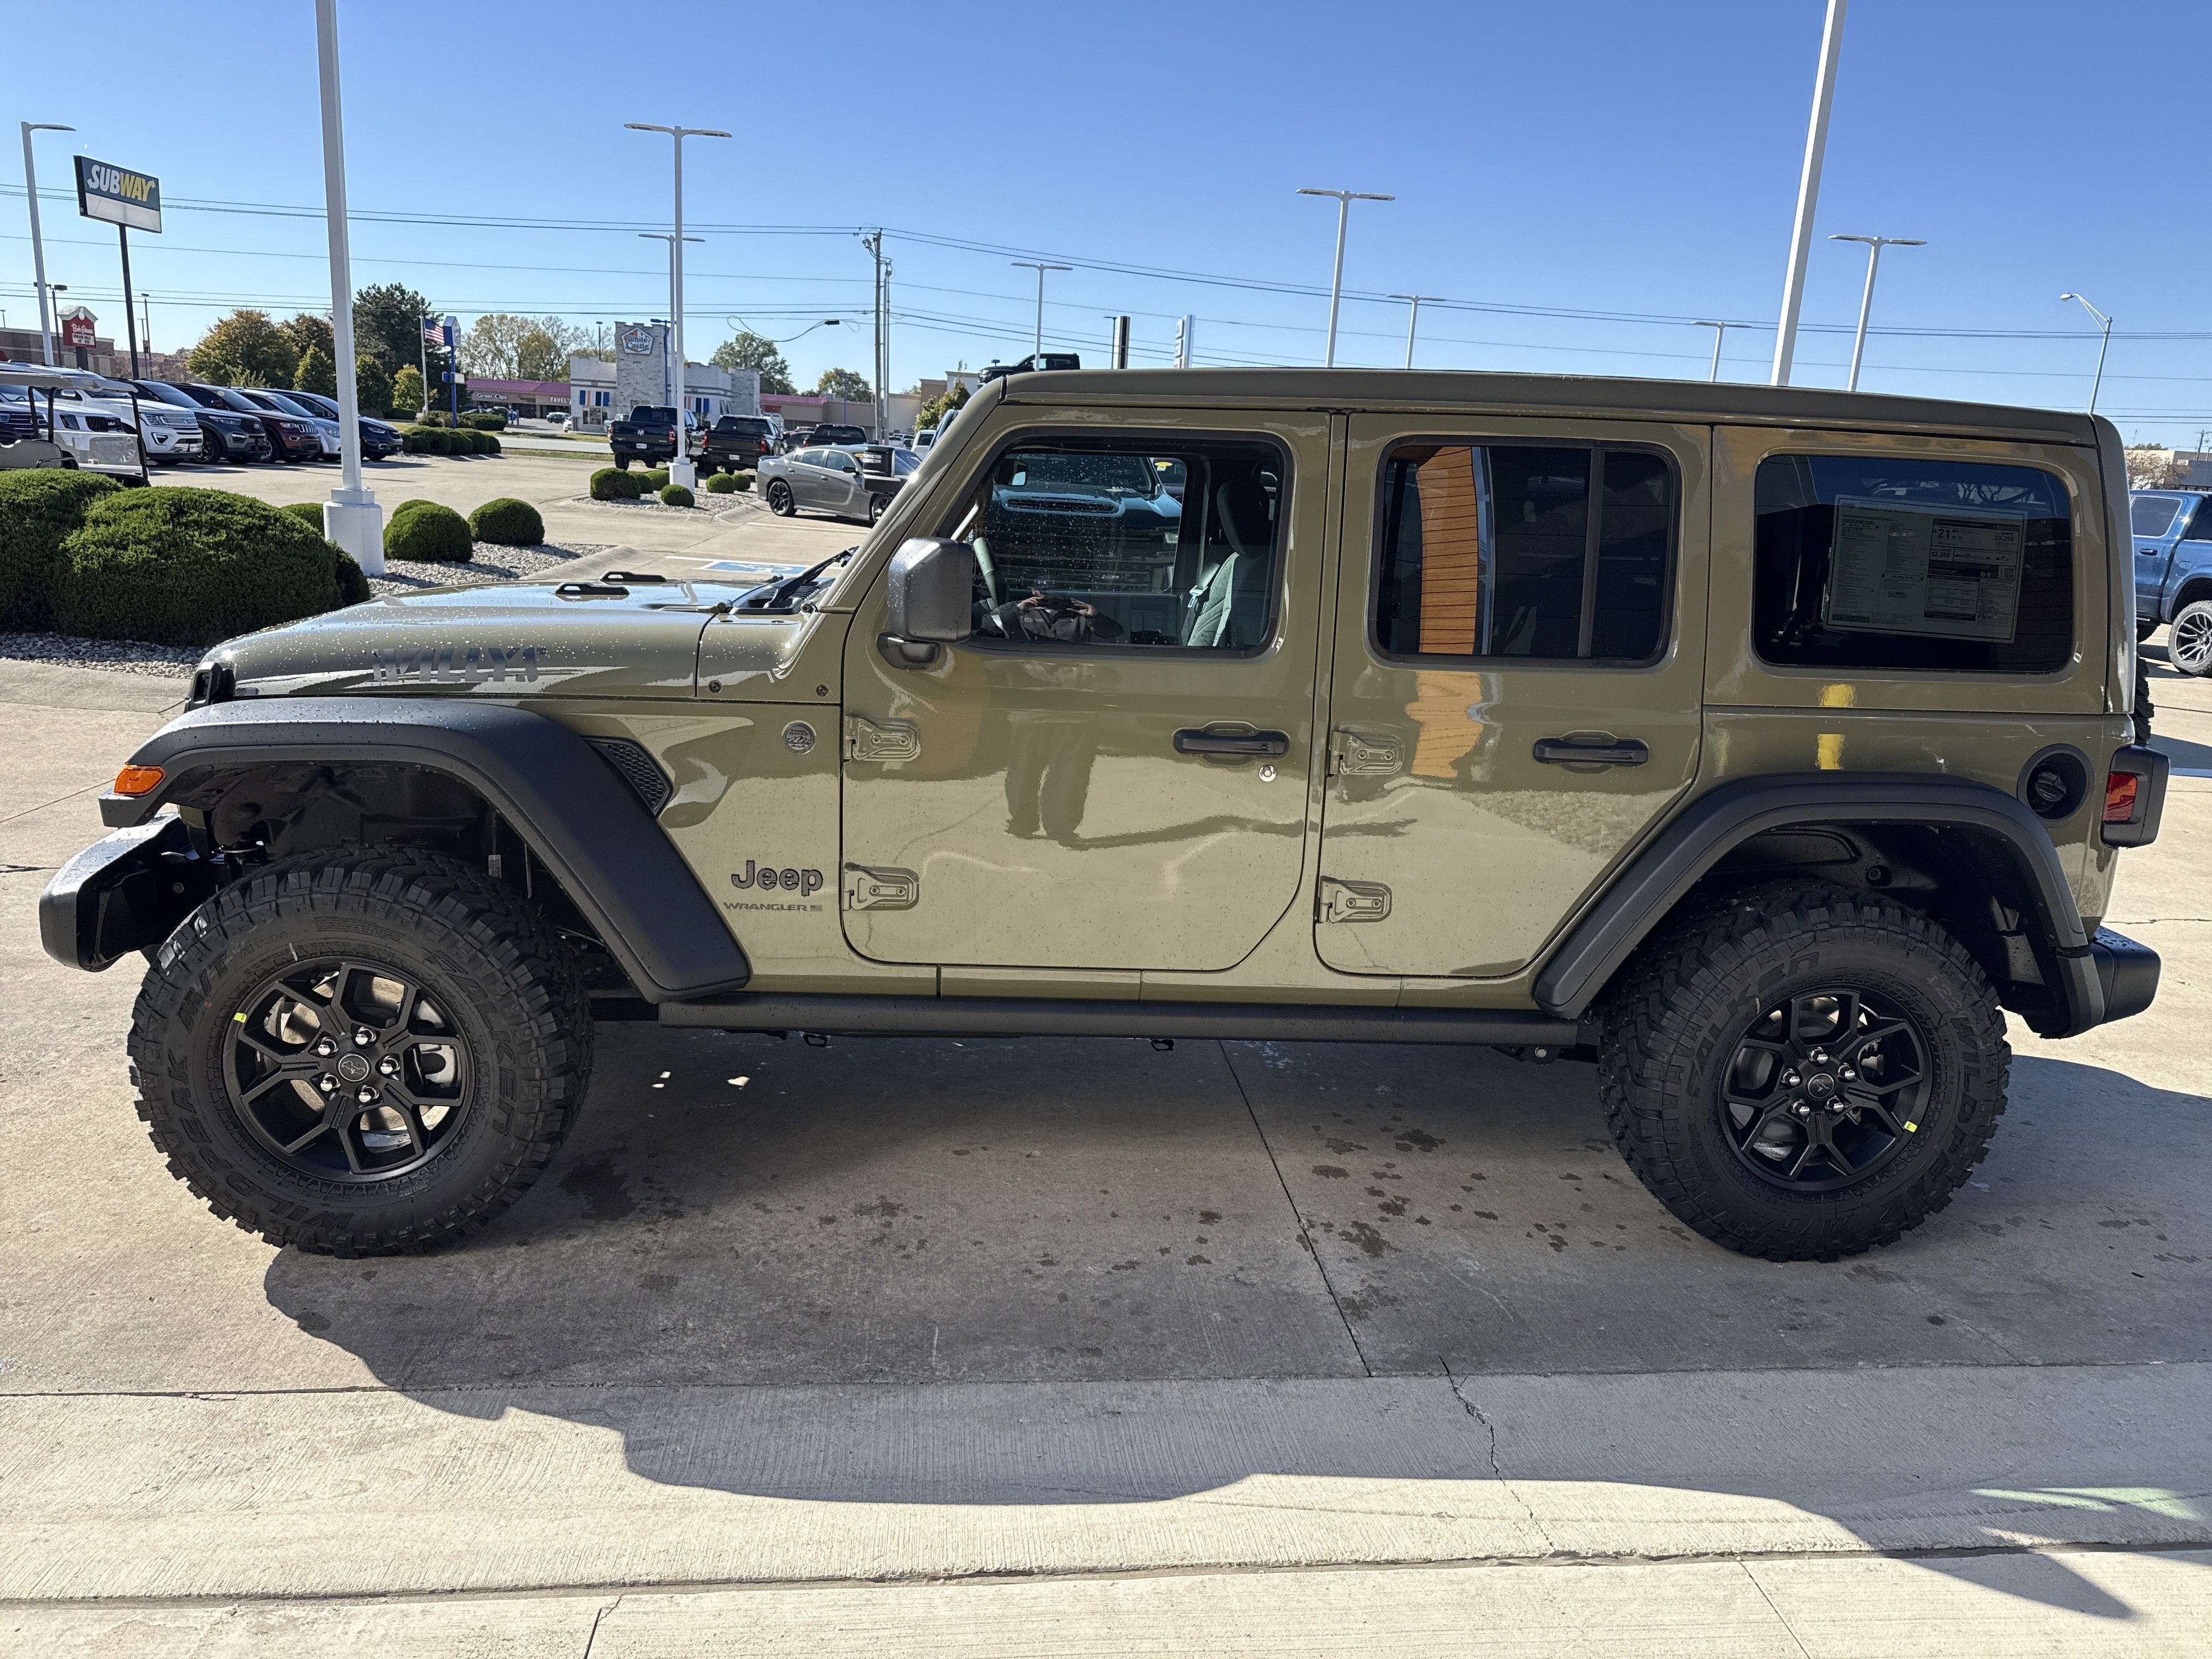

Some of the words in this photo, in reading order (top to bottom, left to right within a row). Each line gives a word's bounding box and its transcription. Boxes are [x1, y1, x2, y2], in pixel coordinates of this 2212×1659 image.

[87, 165, 156, 202] SUBWAY
[1938, 528, 1950, 539] 21
[1977, 613, 2010, 622] FlexCare
[371, 647, 548, 682] WILLYS
[731, 860, 823, 896] Jeep
[723, 901, 808, 912] WRANGLER
